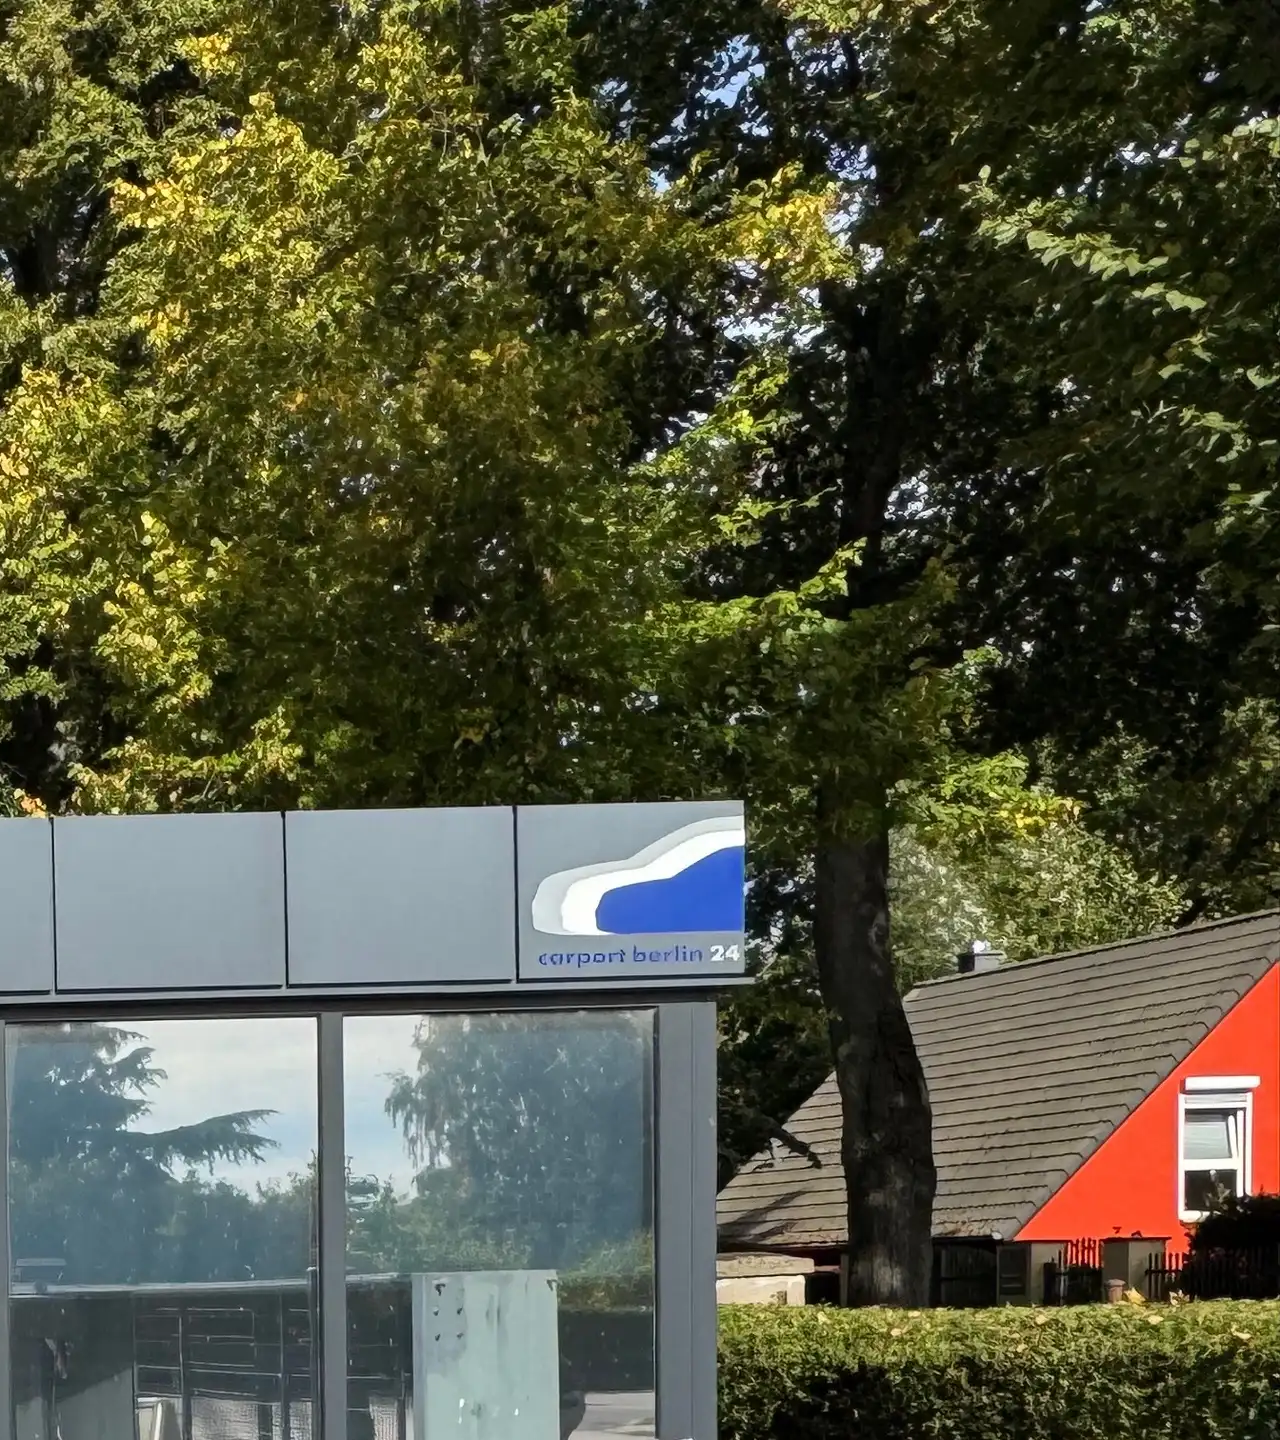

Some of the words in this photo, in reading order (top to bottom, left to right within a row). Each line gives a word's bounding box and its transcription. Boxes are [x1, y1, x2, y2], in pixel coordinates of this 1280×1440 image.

[539, 949, 627, 968] carport
[633, 946, 703, 963] berlin
[710, 944, 740, 962] 24
